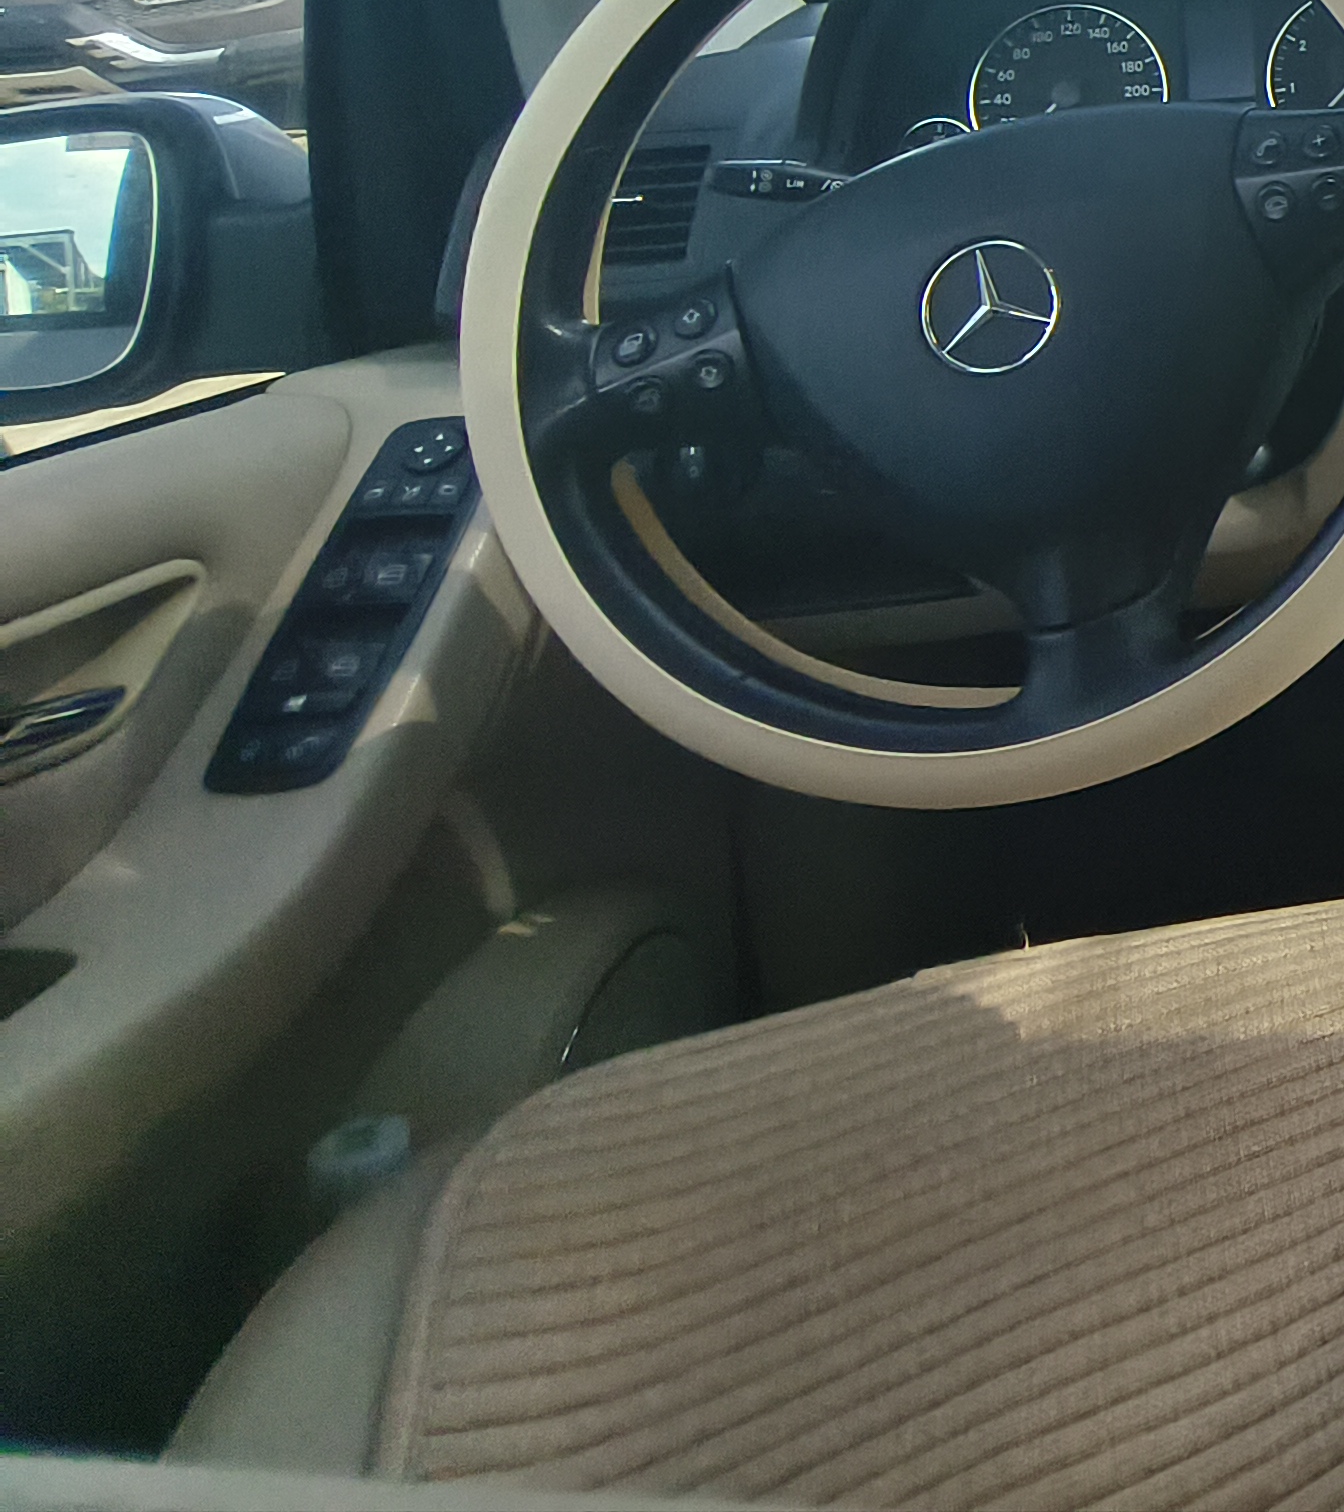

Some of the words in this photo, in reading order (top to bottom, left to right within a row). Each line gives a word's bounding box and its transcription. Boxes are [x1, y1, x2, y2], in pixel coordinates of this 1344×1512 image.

[1087, 27, 1110, 39] 140
[1106, 41, 1129, 54] 160
[1299, 39, 1307, 51] 2
[1012, 48, 1031, 60] 80
[1121, 60, 1143, 73] 180
[997, 69, 1015, 82] 60
[1124, 84, 1150, 98] 200
[1290, 82, 1295, 93] 1
[993, 93, 1012, 105] 40
